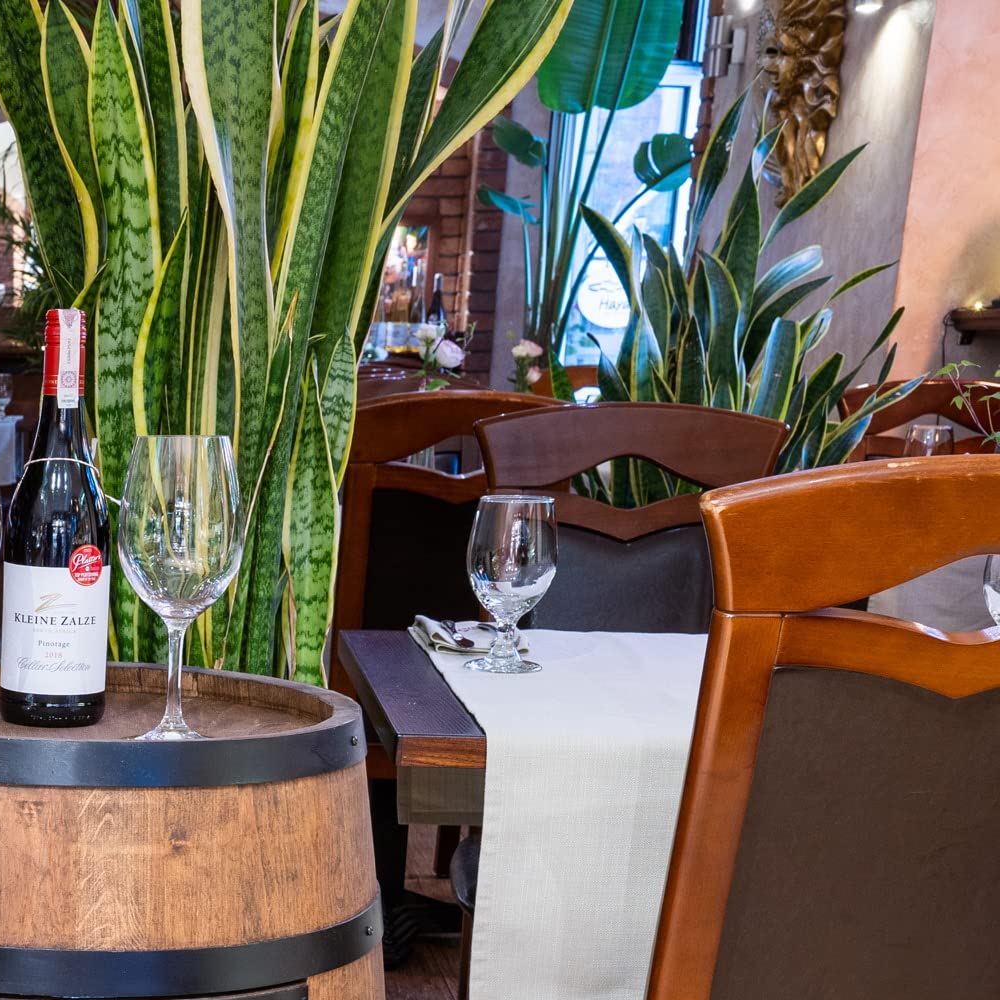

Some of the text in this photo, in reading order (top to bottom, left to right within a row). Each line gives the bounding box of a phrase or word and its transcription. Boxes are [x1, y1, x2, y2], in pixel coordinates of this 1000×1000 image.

[14, 612, 97, 626] KLEINE ZALZE
[38, 639, 71, 648] Pinotage
[45, 651, 63, 659] 2018
